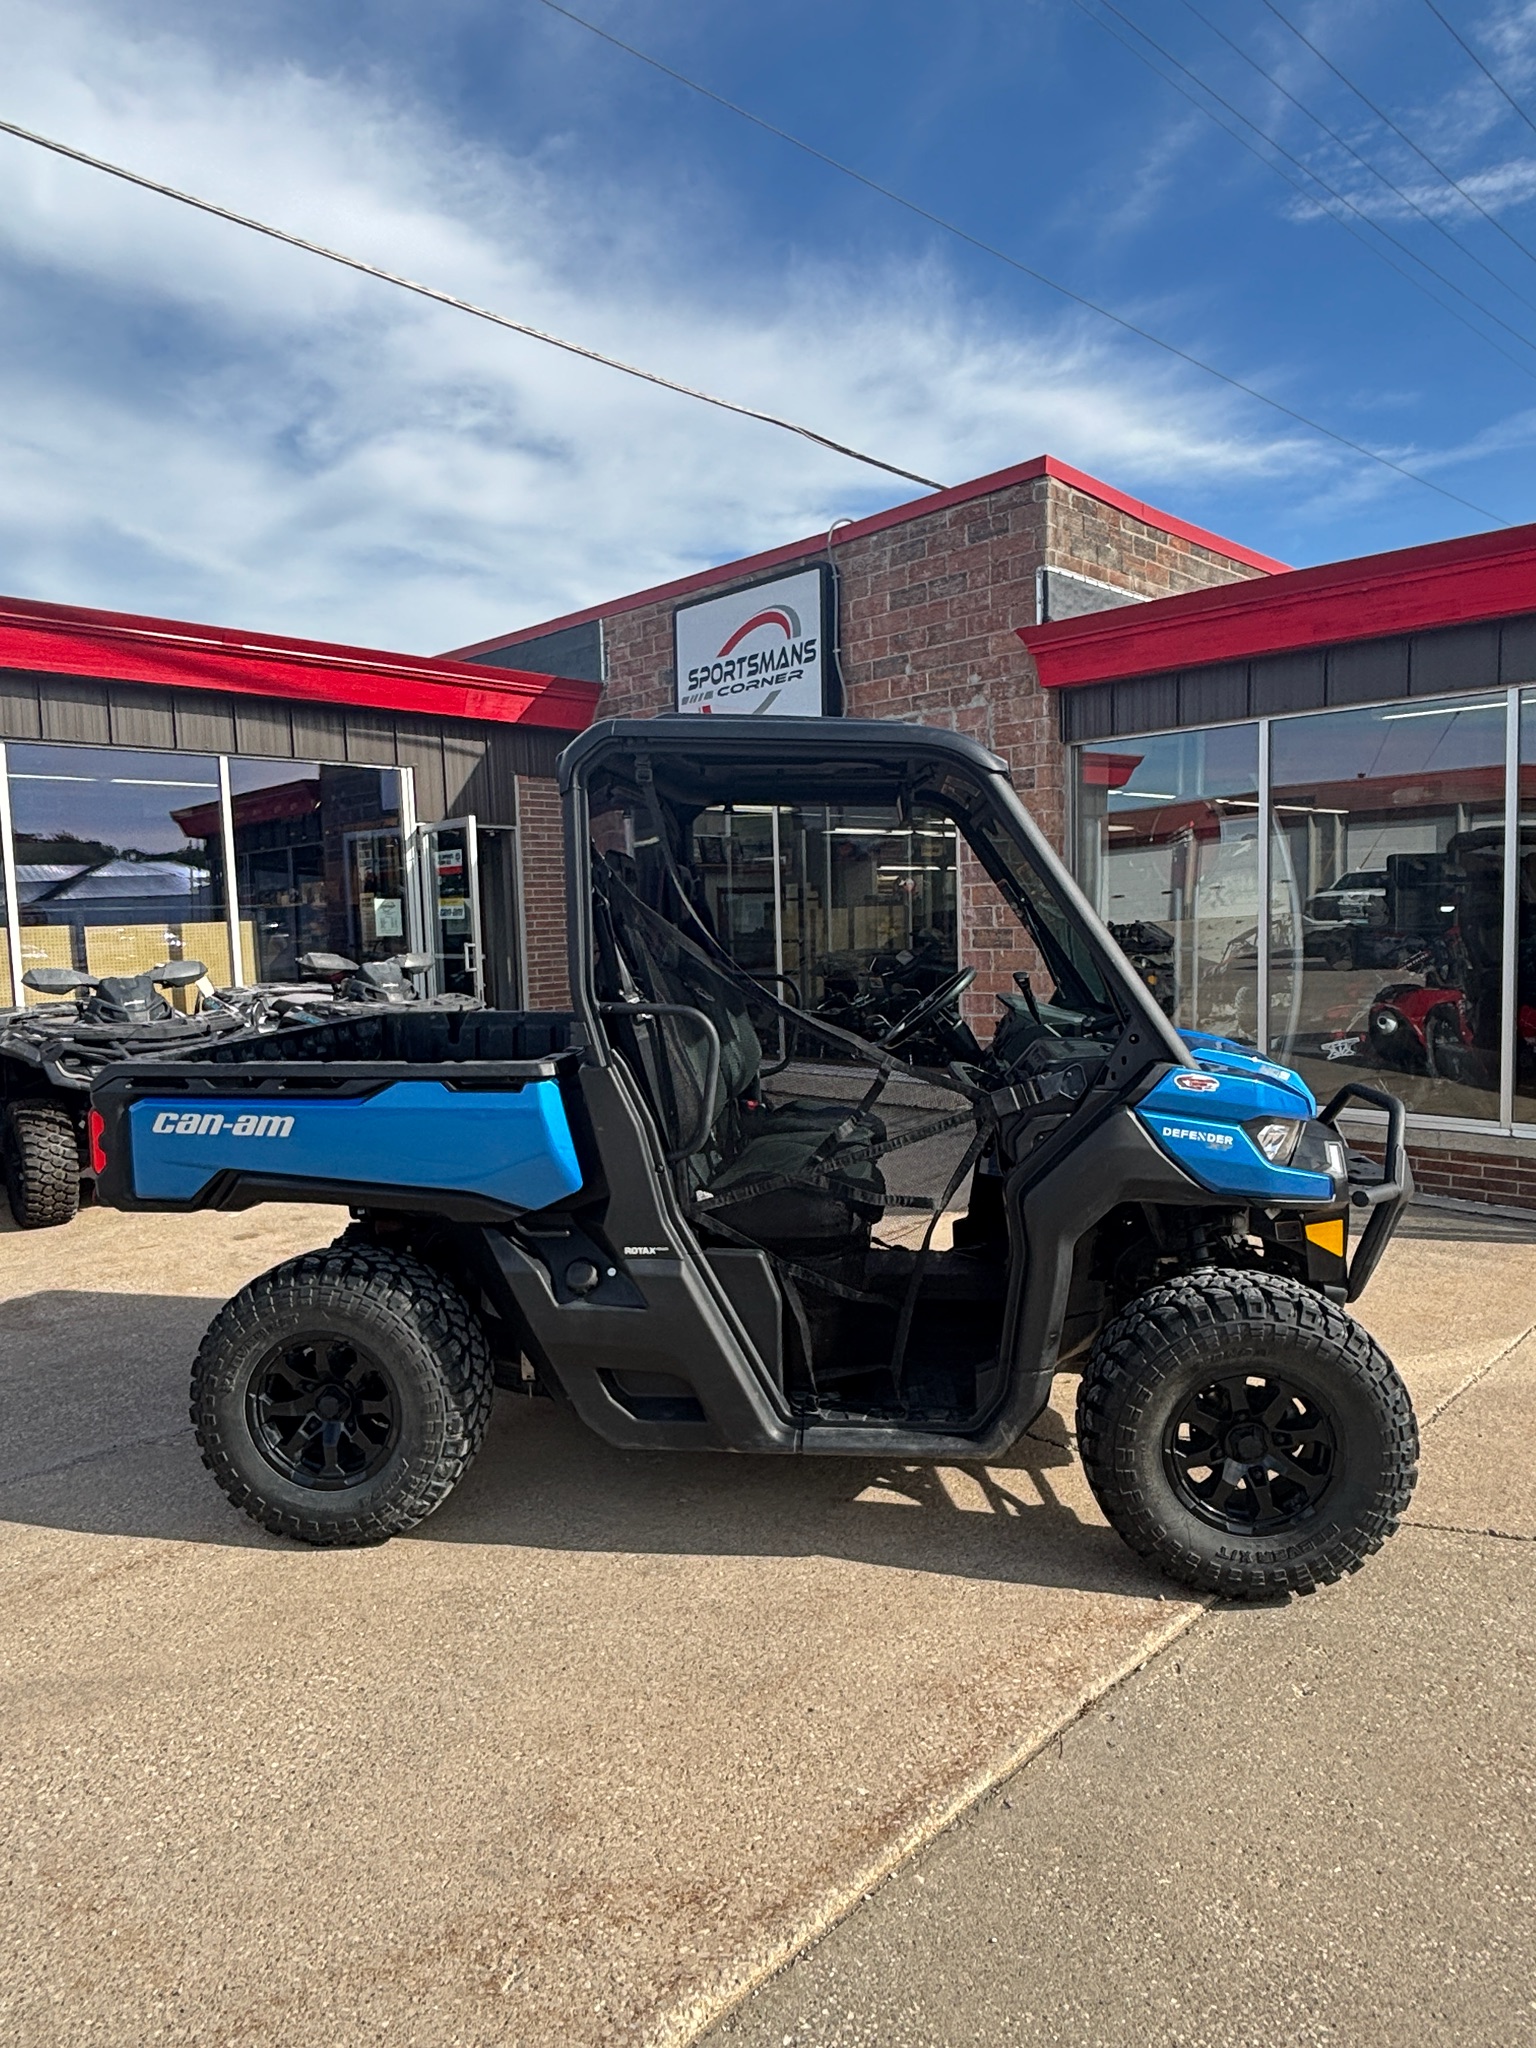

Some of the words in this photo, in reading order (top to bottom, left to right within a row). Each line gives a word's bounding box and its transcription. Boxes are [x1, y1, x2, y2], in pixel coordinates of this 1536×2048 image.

[688, 638, 817, 691] SPORTSMANS
[717, 669, 804, 697] CORNER
[152, 1112, 295, 1137] can-am
[1162, 1126, 1234, 1145] DEFENDER
[624, 1246, 657, 1255] ROTAX
